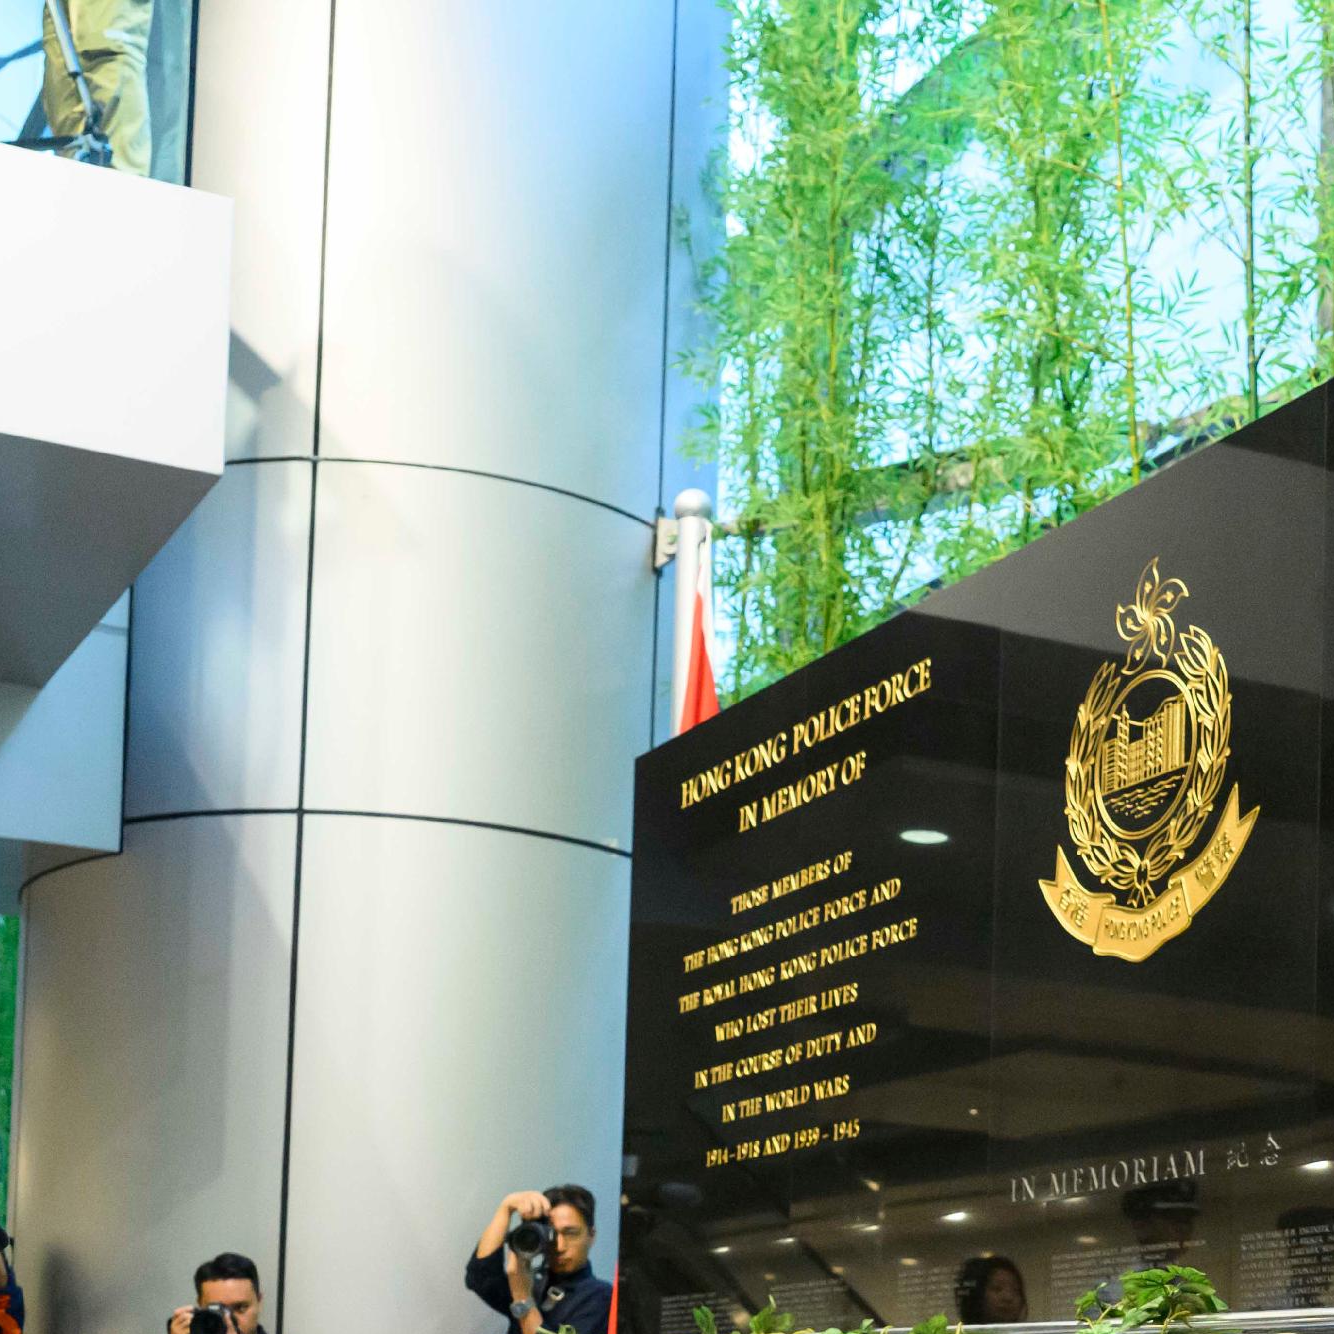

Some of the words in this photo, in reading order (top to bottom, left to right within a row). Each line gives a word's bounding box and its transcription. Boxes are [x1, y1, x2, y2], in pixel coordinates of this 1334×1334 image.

[680, 759, 731, 810] HONG
[733, 732, 787, 784] KONG
[792, 693, 861, 756] POLICE
[862, 657, 932, 721] FORCE
[738, 800, 757, 833] IN
[761, 762, 839, 823] MEMORY
[840, 750, 866, 785] OF
[730, 884, 769, 916] THOSE
[771, 859, 831, 900] MEMBERS
[833, 850, 852, 875] OF
[683, 950, 705, 974] THE
[707, 938, 738, 965] HONG
[740, 924, 773, 953] KONG
[775, 907, 820, 941] POLICE
[823, 889, 867, 923] FORCE
[869, 877, 901, 907] AND
[679, 992, 700, 1014] THE
[702, 980, 736, 1007] ROYAL
[739, 966, 775, 995] HONG
[779, 952, 817, 981] KONG
[820, 934, 868, 969] POLICE
[871, 917, 918, 952] FORCE
[715, 1018, 743, 1042] WHO
[746, 1008, 776, 1034] LOST
[778, 995, 817, 1024] THEIR
[820, 982, 858, 1011] LIVES
[694, 1069, 708, 1090] IN
[711, 1062, 733, 1085] THE
[735, 1048, 782, 1079] COURSE
[785, 1042, 802, 1065] OF
[806, 1031, 842, 1060] DUTY
[846, 1022, 877, 1049] AND
[722, 1103, 736, 1124] IN
[738, 1097, 762, 1119] THE
[765, 1084, 810, 1113] WORLD
[813, 1074, 850, 1101] WARS
[762, 1133, 791, 1157] AND
[794, 1126, 820, 1150] 1939
[833, 1118, 860, 1142] 1945
[1010, 1175, 1036, 1203] IN
[1049, 1150, 1206, 1197] MEMORIAM
